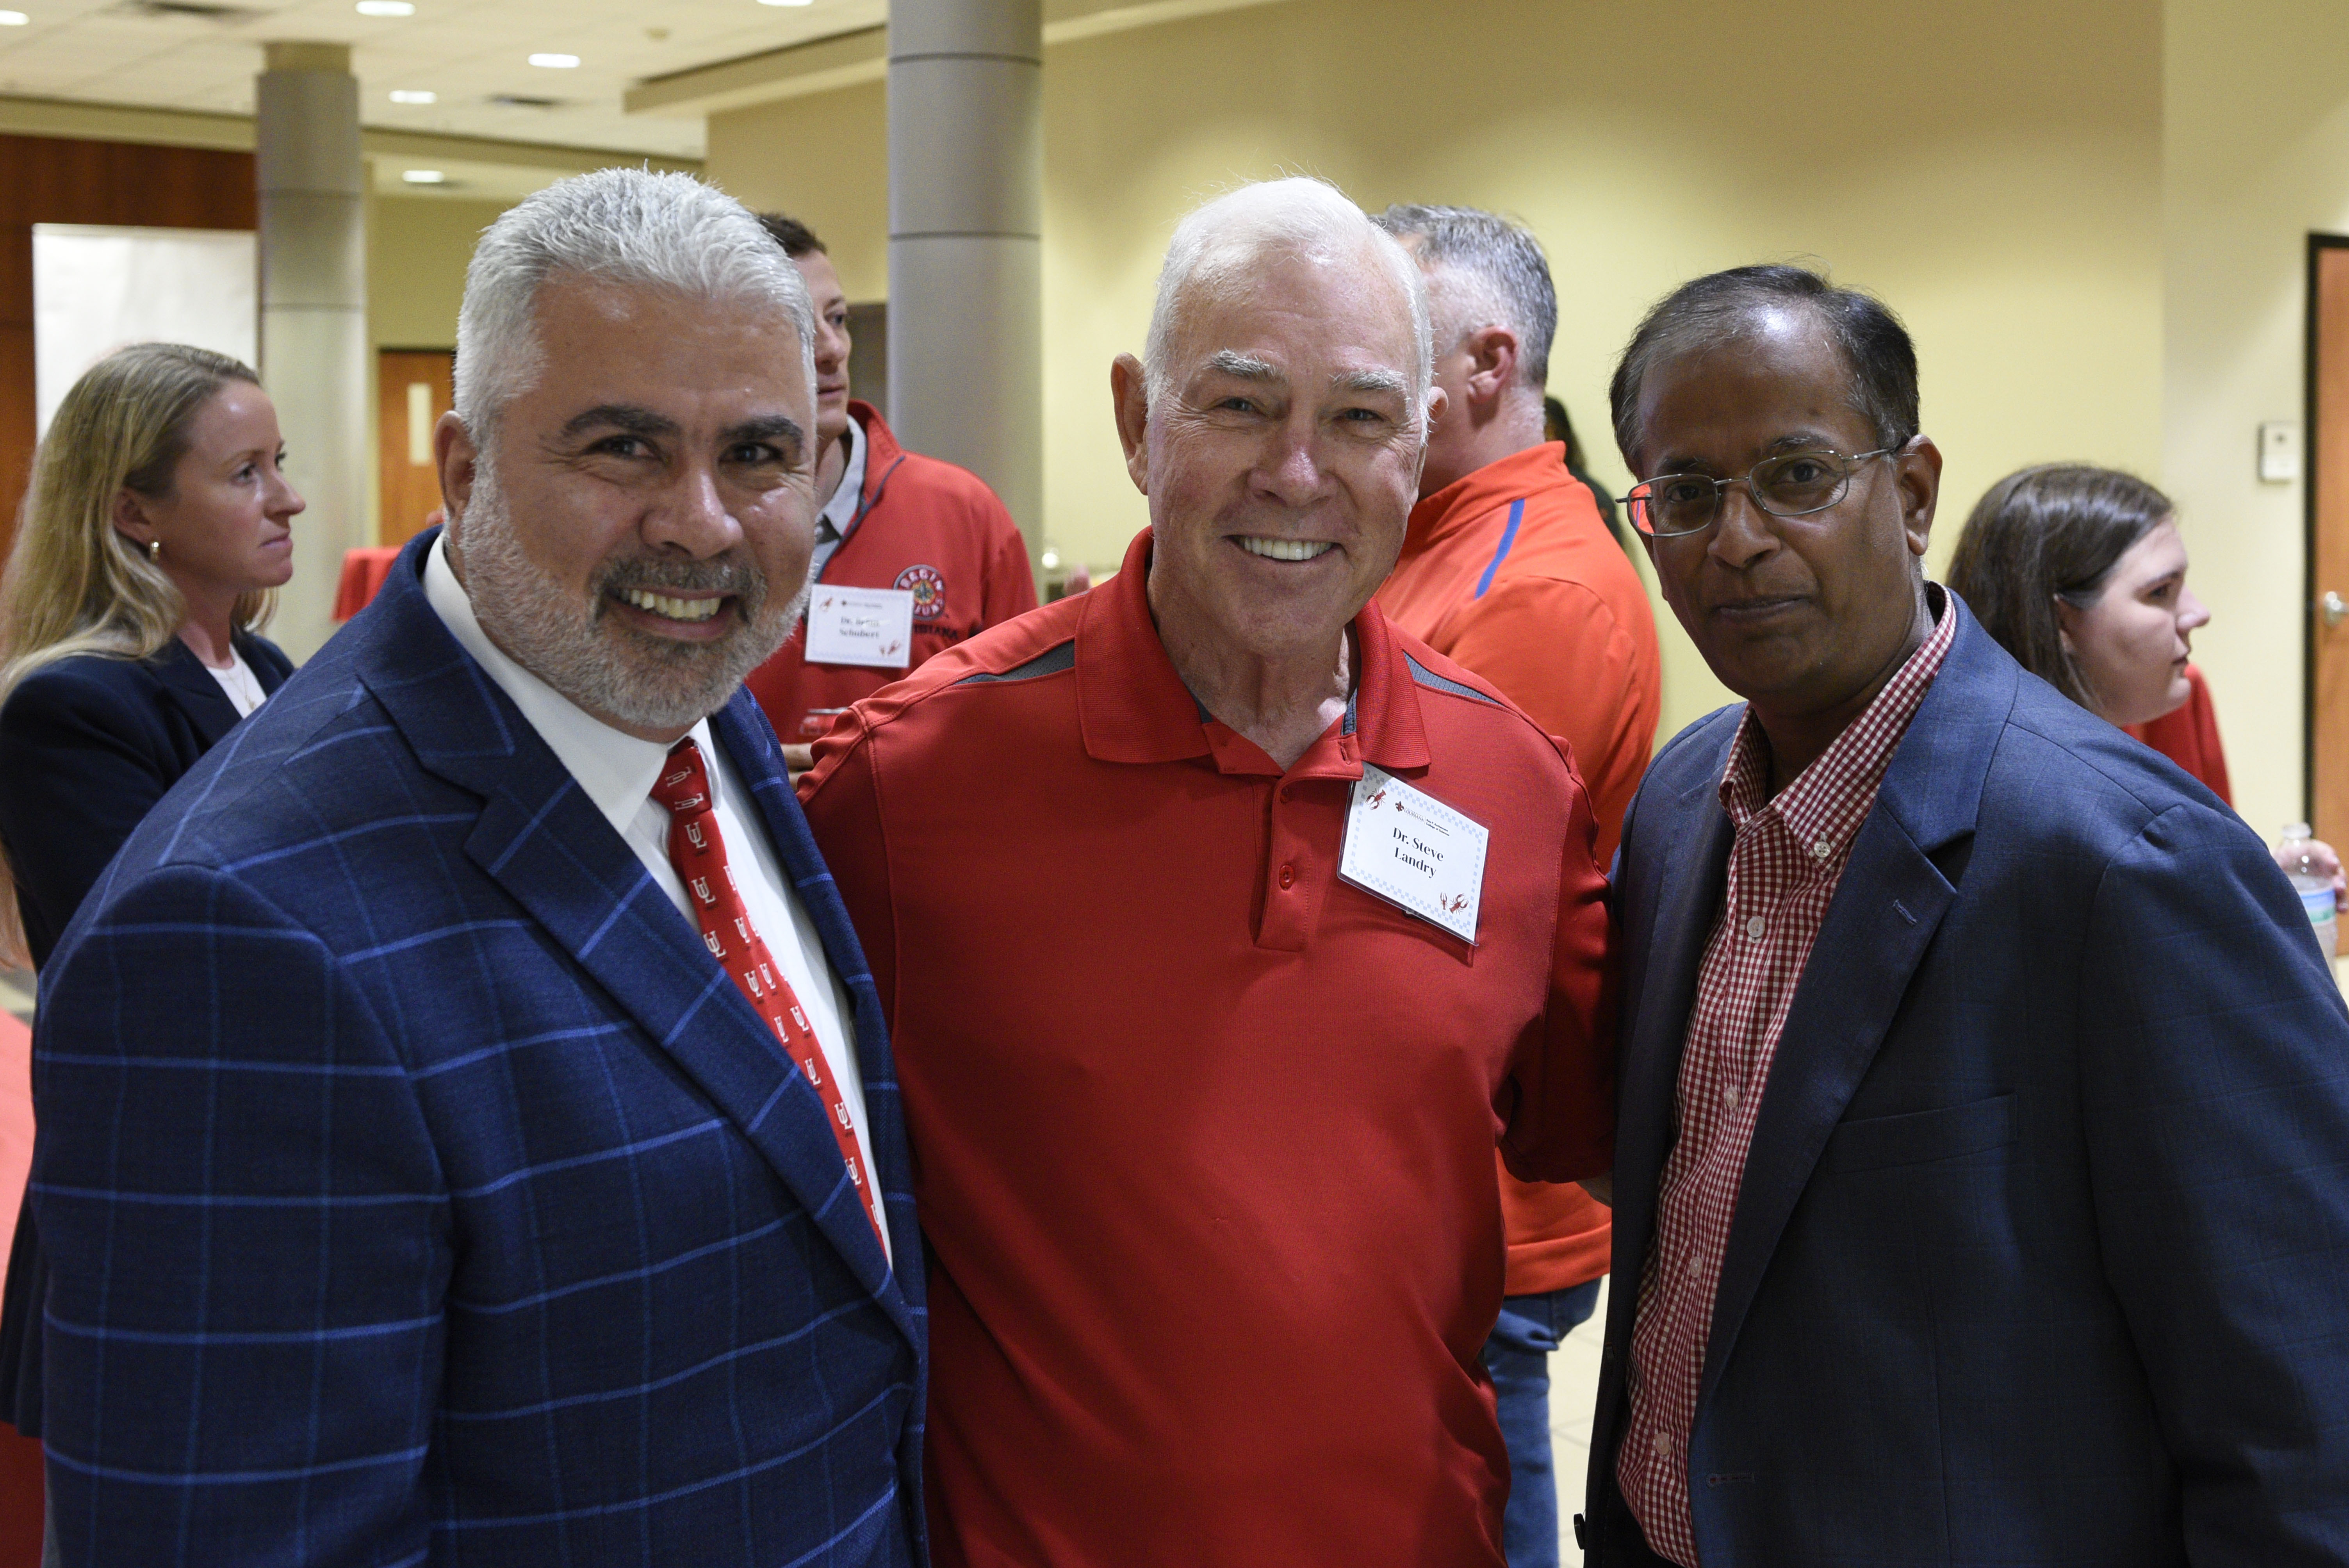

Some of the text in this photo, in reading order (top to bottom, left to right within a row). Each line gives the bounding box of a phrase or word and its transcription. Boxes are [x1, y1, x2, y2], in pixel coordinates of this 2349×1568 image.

[1393, 827, 1444, 862] Dr. Steve
[1395, 847, 1437, 879] Landry
